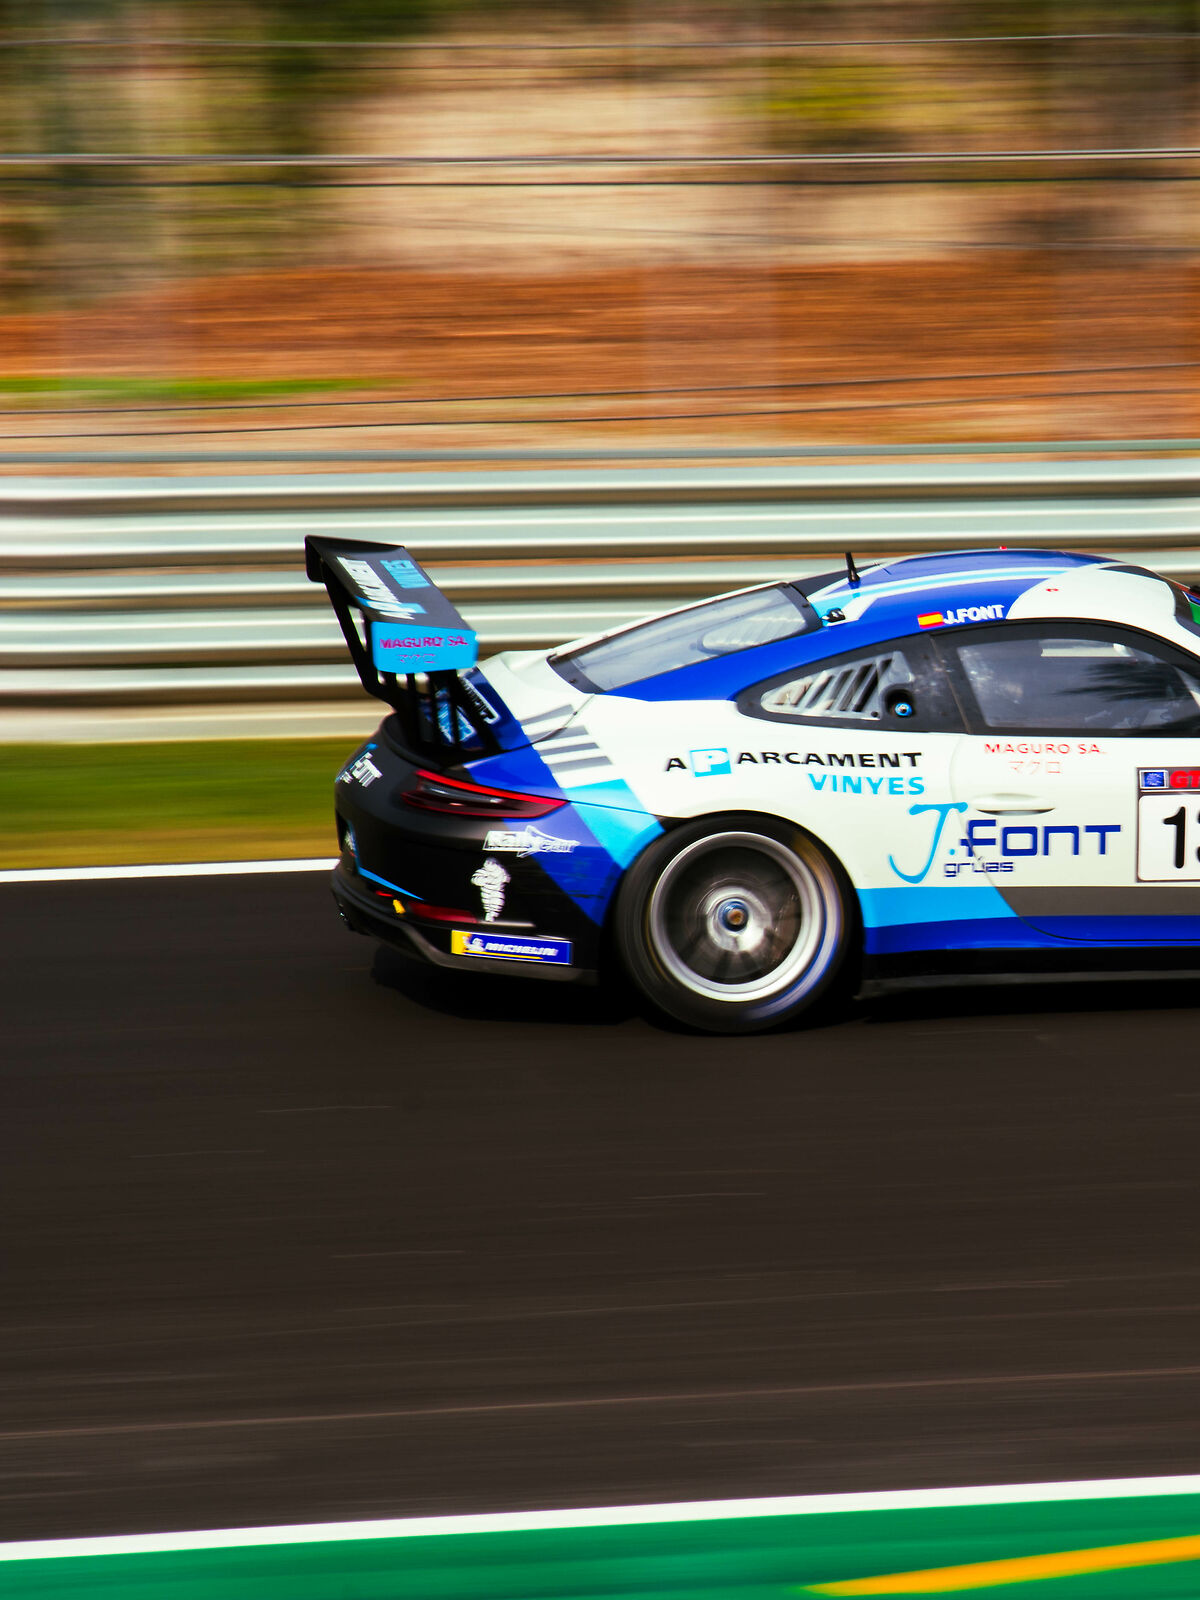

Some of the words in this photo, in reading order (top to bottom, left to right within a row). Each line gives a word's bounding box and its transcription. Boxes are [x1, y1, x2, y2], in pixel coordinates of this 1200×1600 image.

[943, 604, 1005, 625] J.FONT
[380, 636, 443, 649] MAGURO
[984, 743, 1070, 755] MAGURO
[807, 773, 925, 795] VINYES
